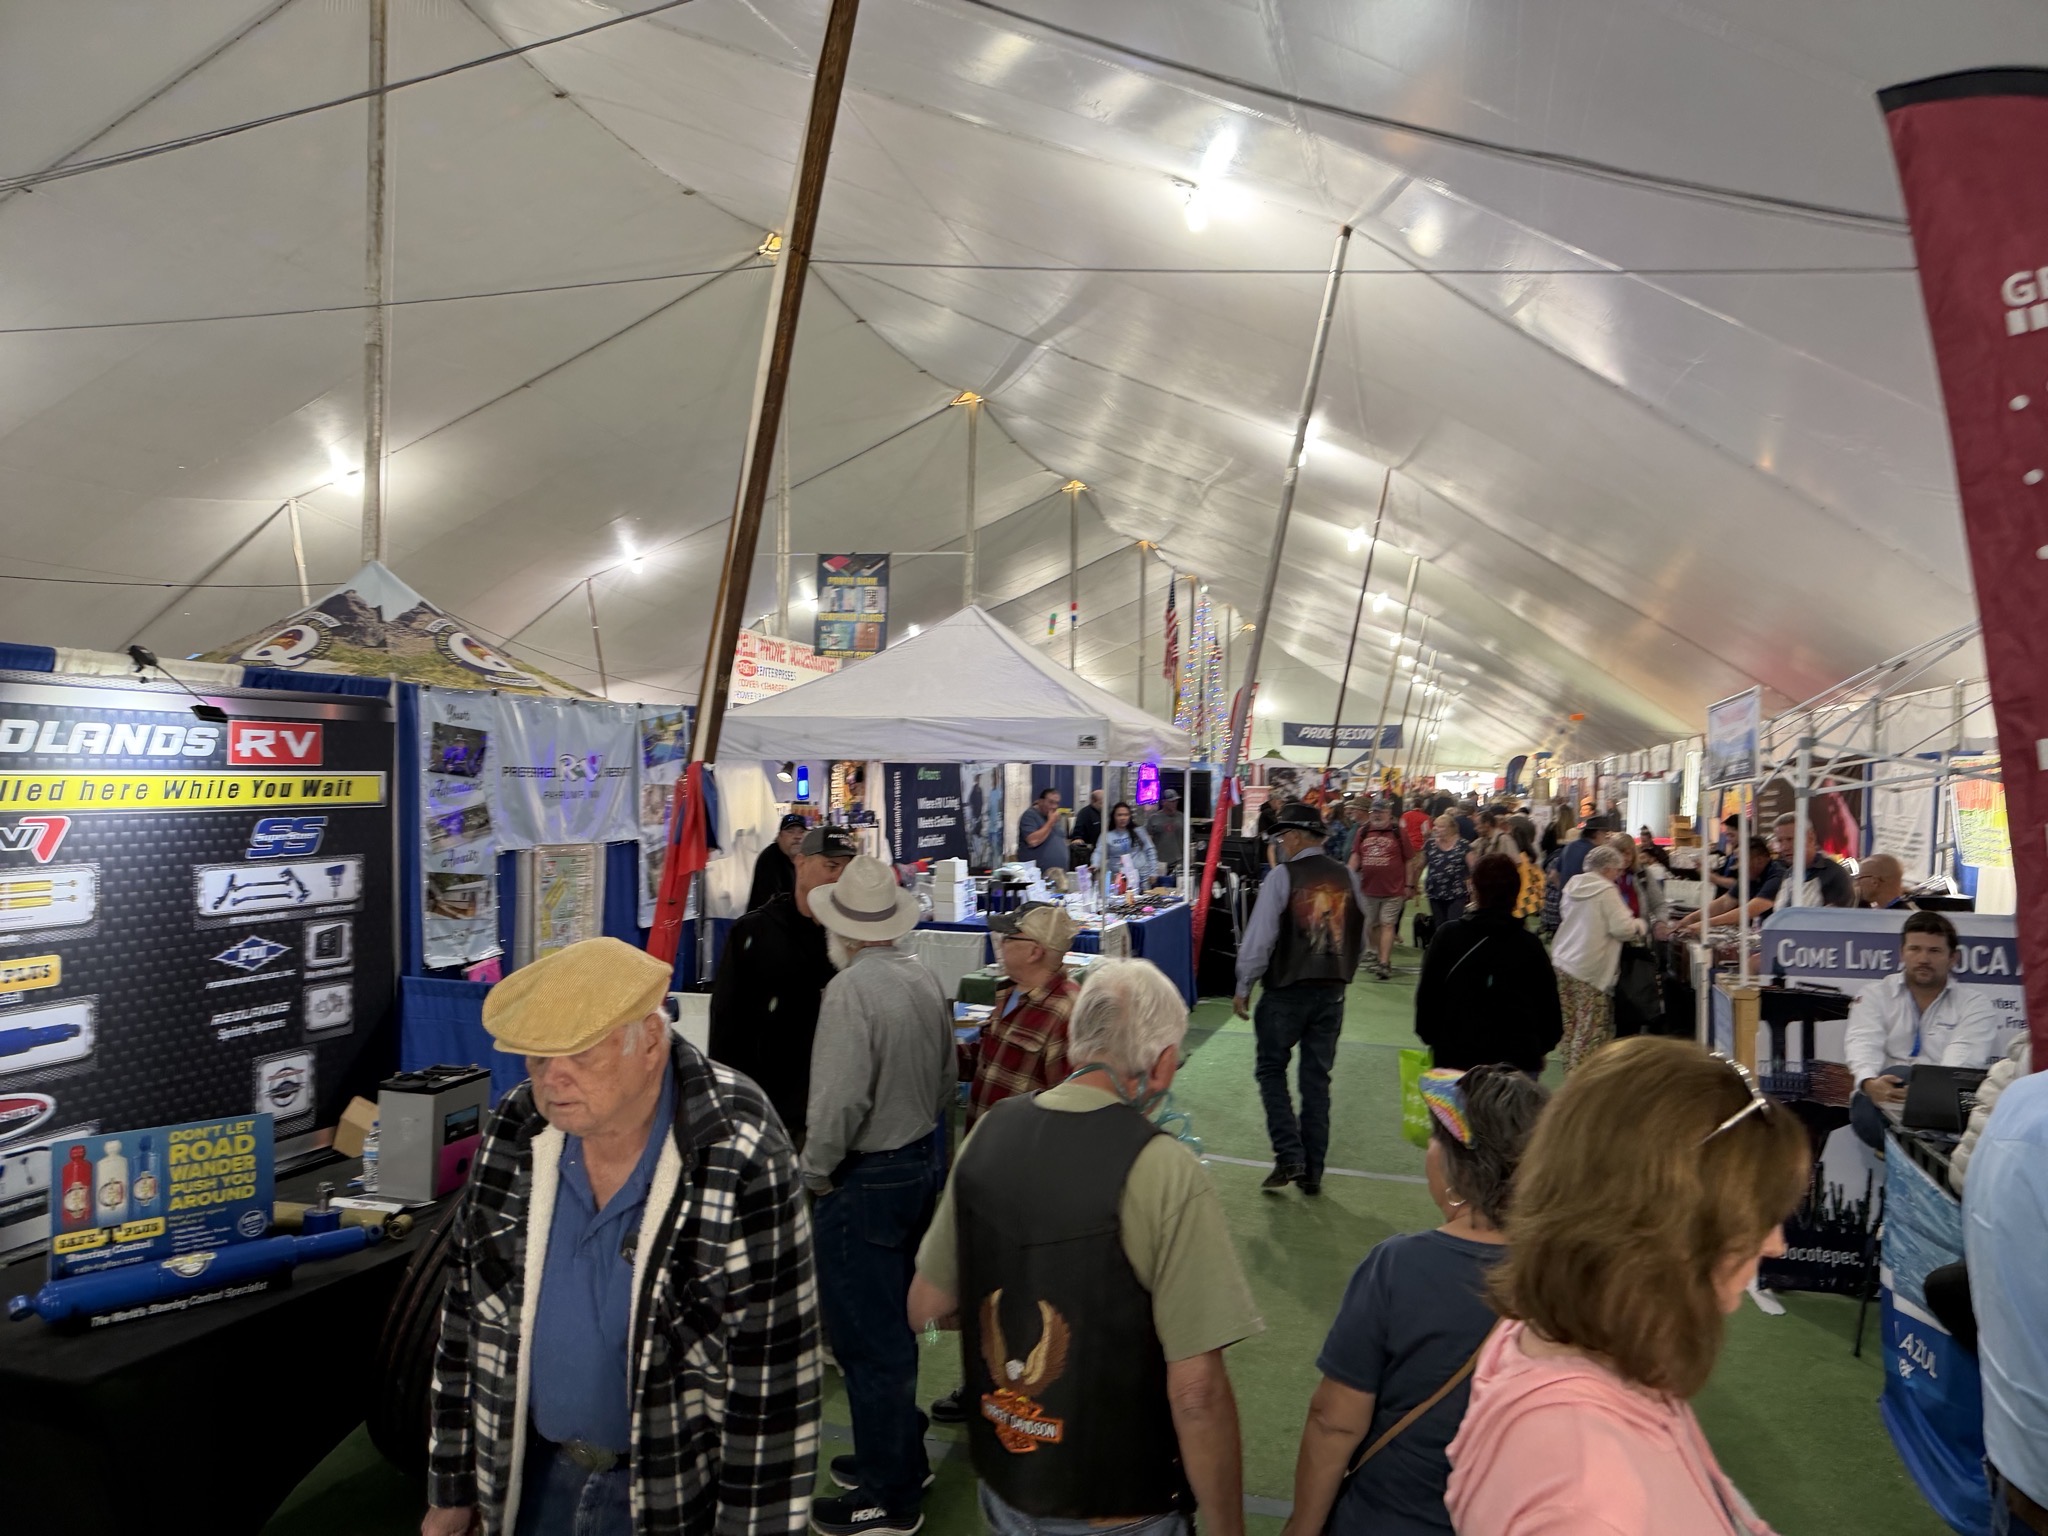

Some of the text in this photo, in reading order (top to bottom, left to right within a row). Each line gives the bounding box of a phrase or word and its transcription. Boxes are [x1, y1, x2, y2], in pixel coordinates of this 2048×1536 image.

[234, 729, 317, 758] RV
[79, 779, 149, 800] here
[163, 778, 240, 800] While
[251, 777, 294, 799] You
[302, 777, 354, 797] Wait
[168, 1120, 256, 1143] DON'T LET
[168, 1134, 257, 1165] ROAD
[169, 1154, 257, 1182] WANDER
[169, 1171, 257, 1196] PUSH YOU
[168, 1184, 256, 1212] AROUND
[1010, 1414, 1058, 1438] DAVIDSON
